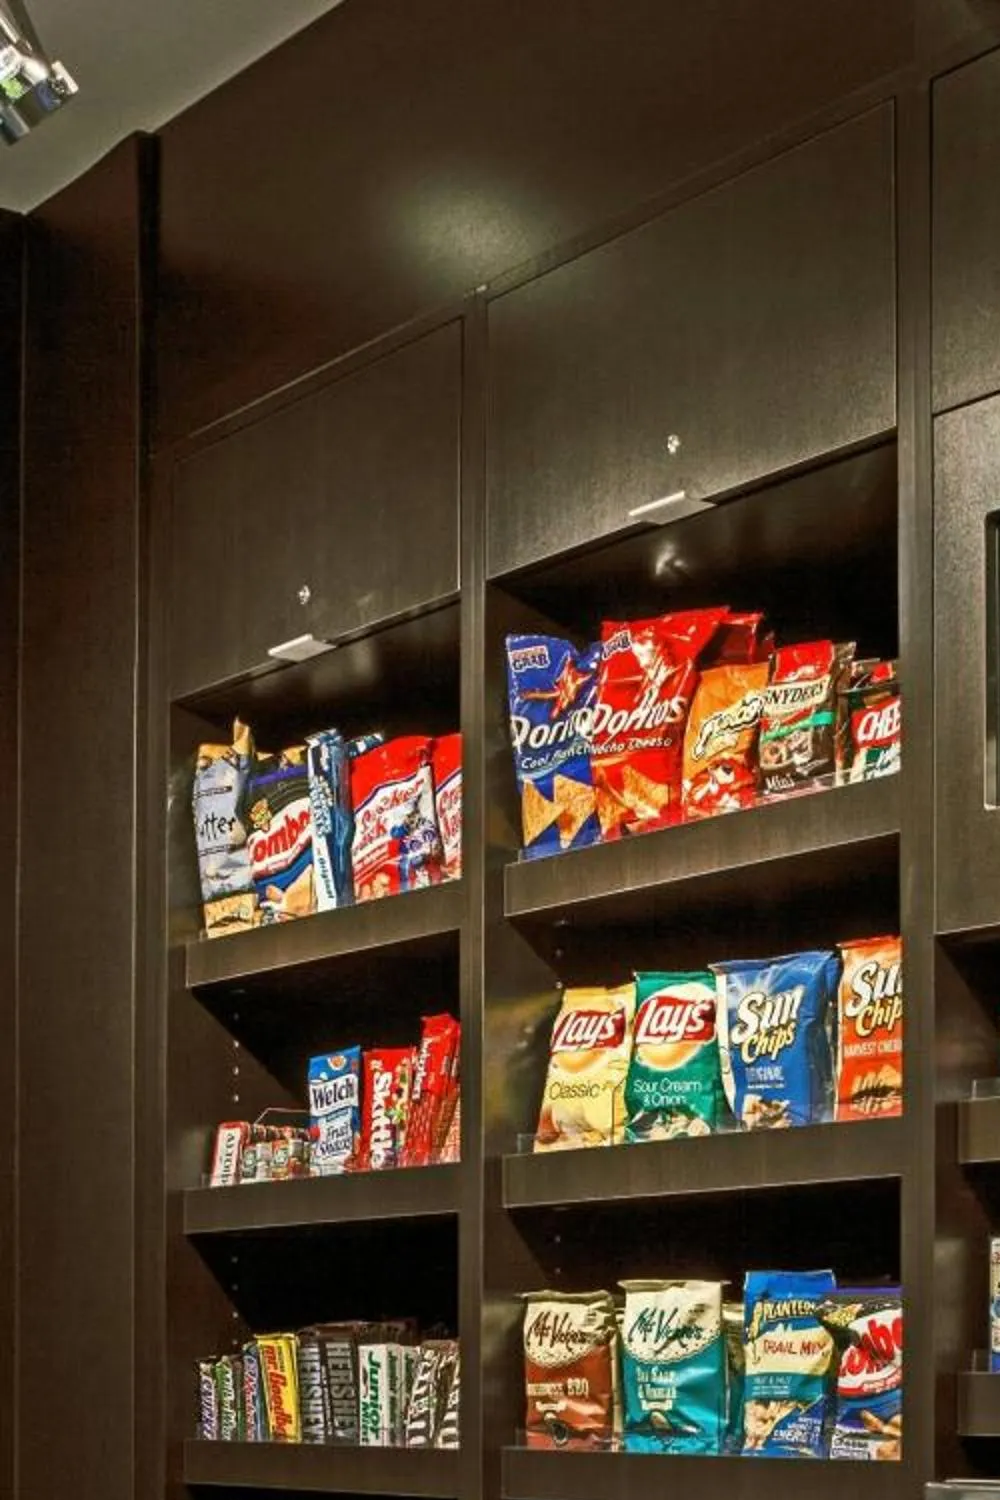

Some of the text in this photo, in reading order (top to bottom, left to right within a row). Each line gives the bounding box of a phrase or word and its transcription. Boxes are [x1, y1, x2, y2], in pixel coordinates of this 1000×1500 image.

[731, 985, 805, 1045] Sun
[741, 1022, 796, 1064] Chips
[549, 1080, 601, 1100] Classic
[633, 1079, 702, 1093] Sour Cream
[368, 1351, 382, 1441] Junior
